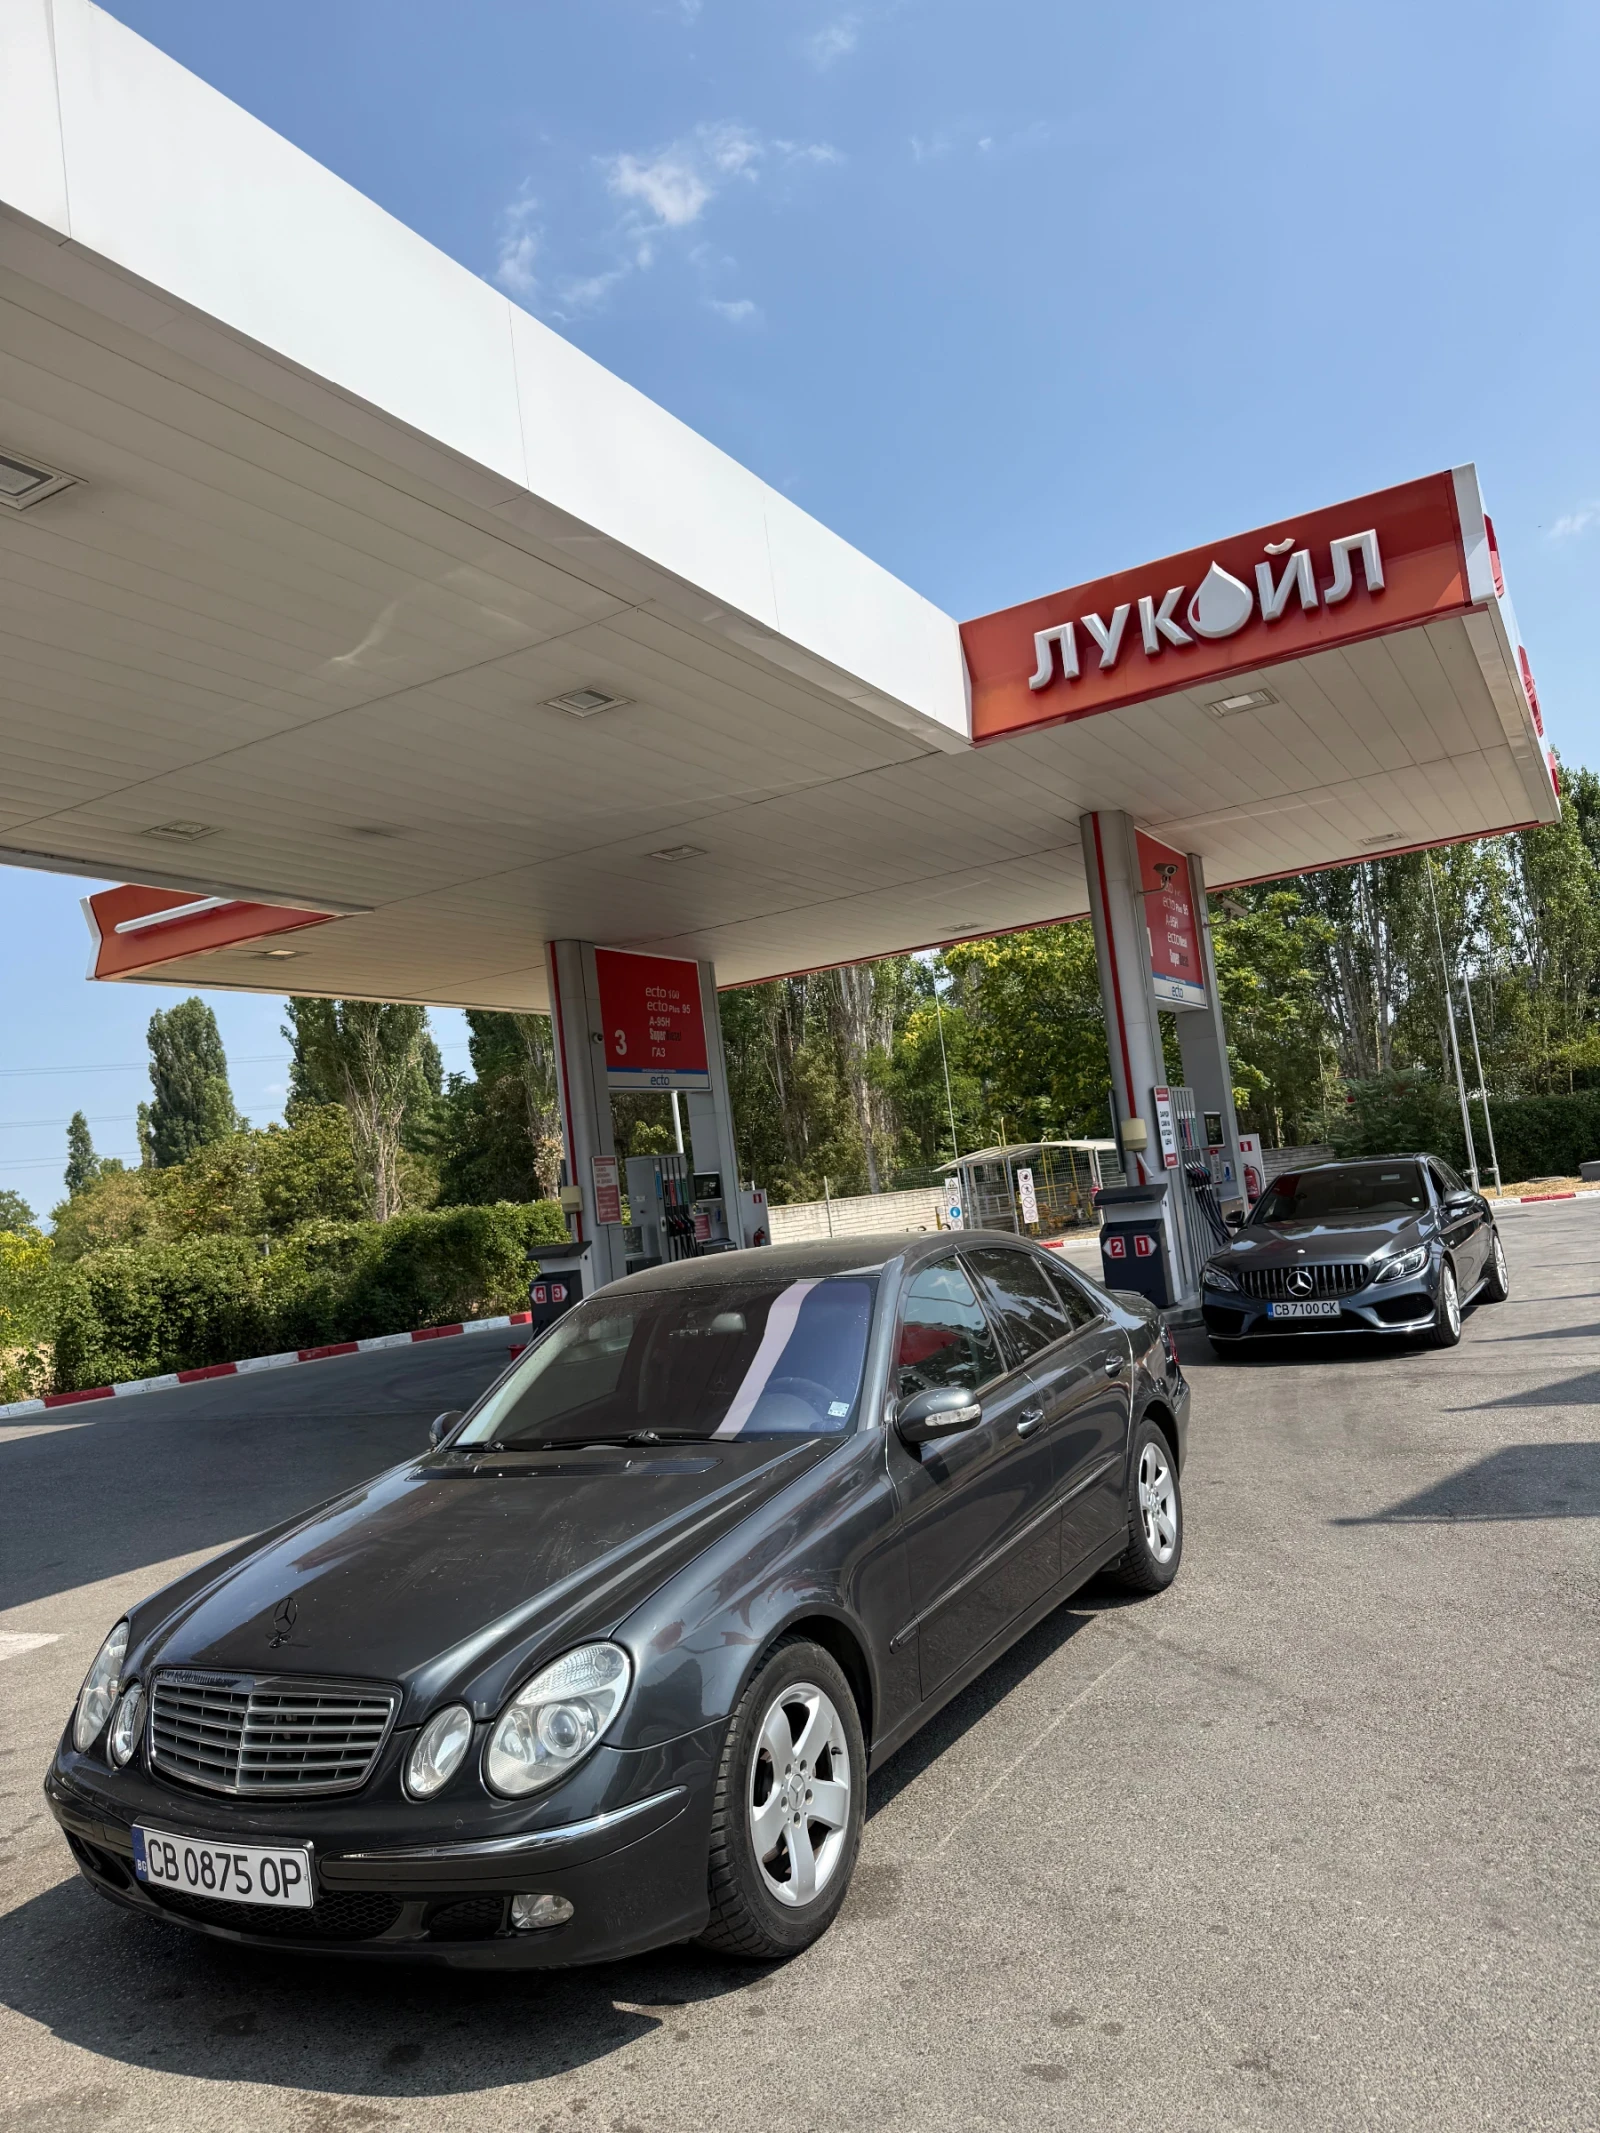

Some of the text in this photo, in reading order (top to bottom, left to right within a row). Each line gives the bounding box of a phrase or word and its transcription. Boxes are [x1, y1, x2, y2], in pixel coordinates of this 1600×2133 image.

[645, 985, 680, 1000] ecto 100
[647, 1000, 668, 1012] ecto
[682, 1004, 691, 1014] 95
[614, 1029, 628, 1056] 3
[651, 1047, 666, 1058] ГАЗ
[650, 1075, 670, 1086] ecto
[1112, 1241, 1122, 1253] 2
[1139, 1240, 1146, 1252] 1
[537, 1289, 544, 1299] 4
[554, 1288, 561, 1298] 3
[1275, 1304, 1290, 1316] CB
[1291, 1303, 1320, 1315] 7100
[1321, 1302, 1337, 1314] CK
[136, 1859, 147, 1871] BG
[148, 1839, 302, 1899] CB 0875 OP
